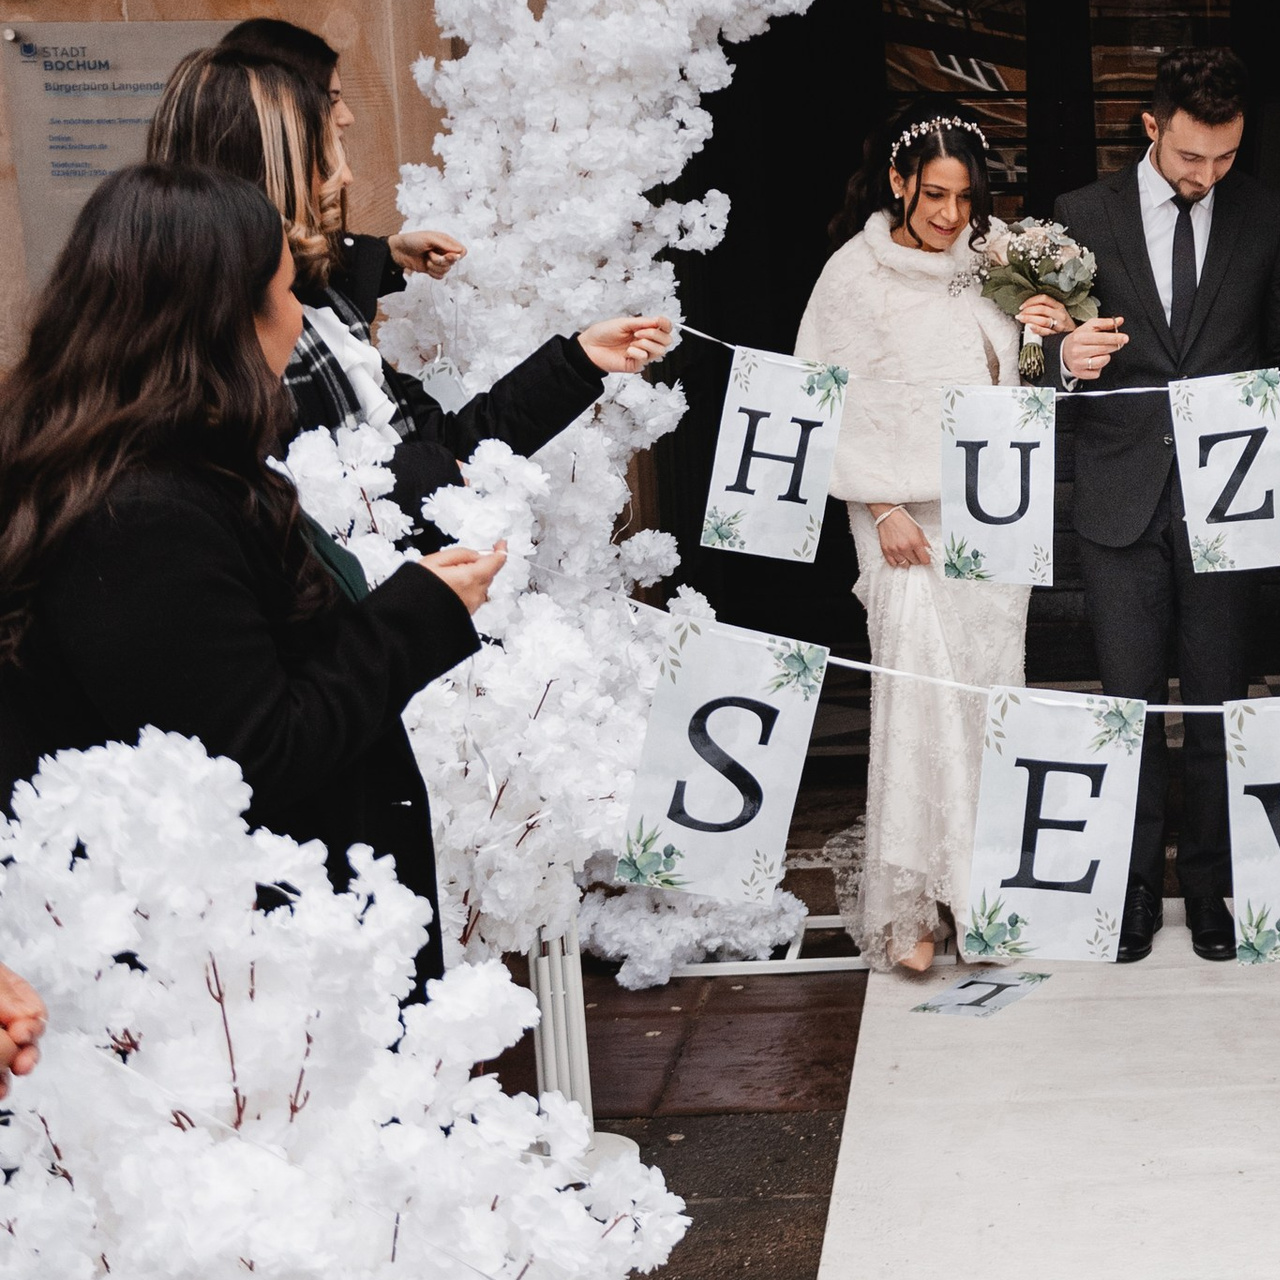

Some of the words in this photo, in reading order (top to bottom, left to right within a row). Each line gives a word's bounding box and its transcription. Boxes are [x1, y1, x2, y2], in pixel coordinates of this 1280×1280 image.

[41, 46, 88, 58] STADT
[44, 60, 110, 71] BOCHUM
[44, 81, 109, 93] Bürgerbüro
[112, 81, 165, 93] Langendr
